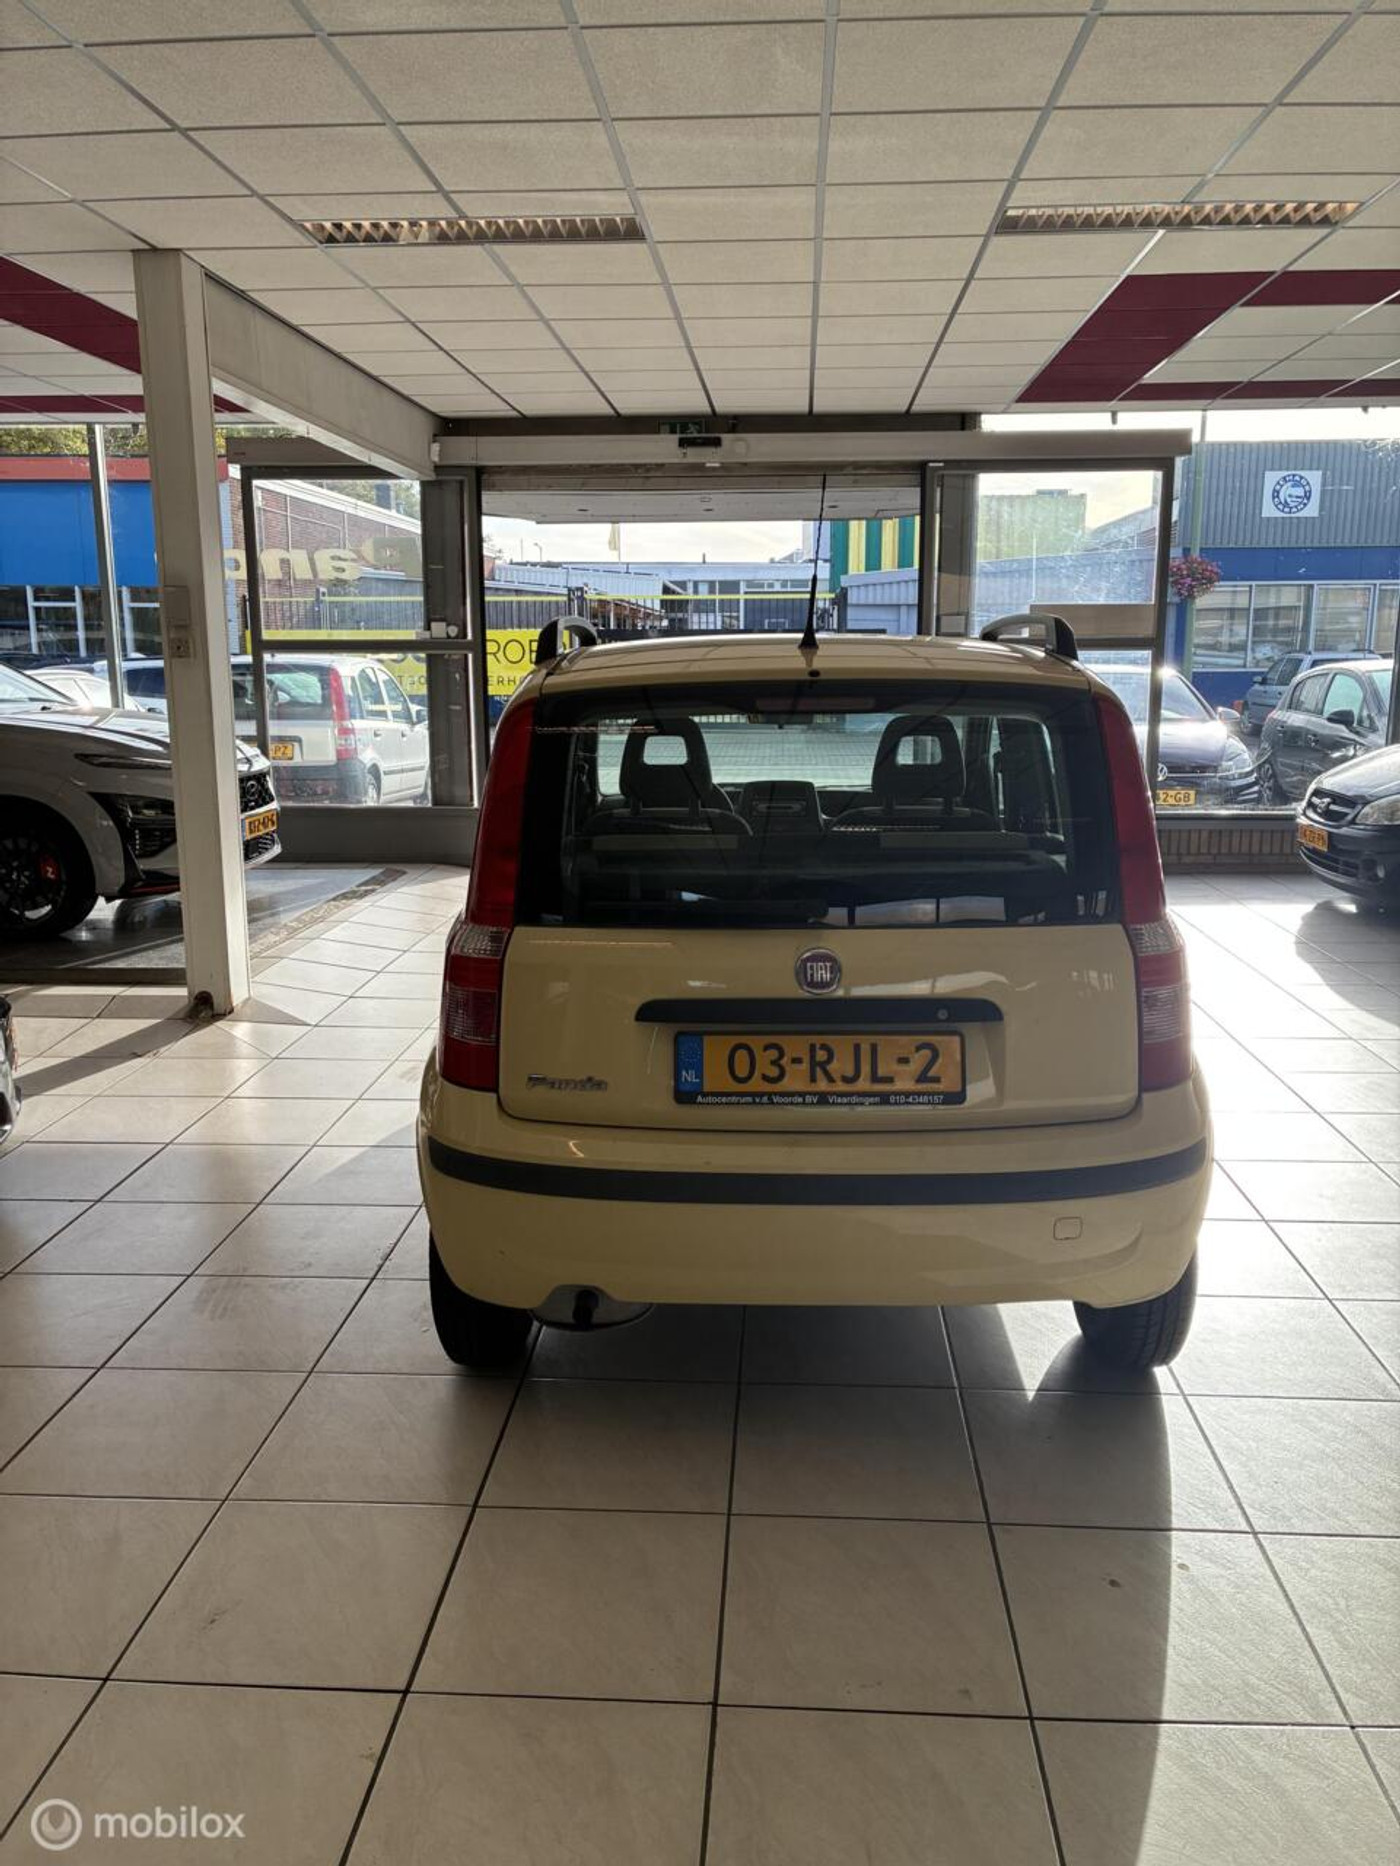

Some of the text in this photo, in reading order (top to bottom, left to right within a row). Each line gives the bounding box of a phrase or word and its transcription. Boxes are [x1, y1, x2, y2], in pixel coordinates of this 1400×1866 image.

[807, 962, 831, 982] FIAT
[728, 1043, 941, 1085] 03-RJL-2
[526, 1074, 608, 1092] Panda
[681, 1070, 699, 1082] NL
[696, 1094, 753, 1104] Autocentrum
[772, 1094, 803, 1104] Voorde
[805, 1094, 819, 1104] BV
[827, 1094, 880, 1106] Vlaardingen
